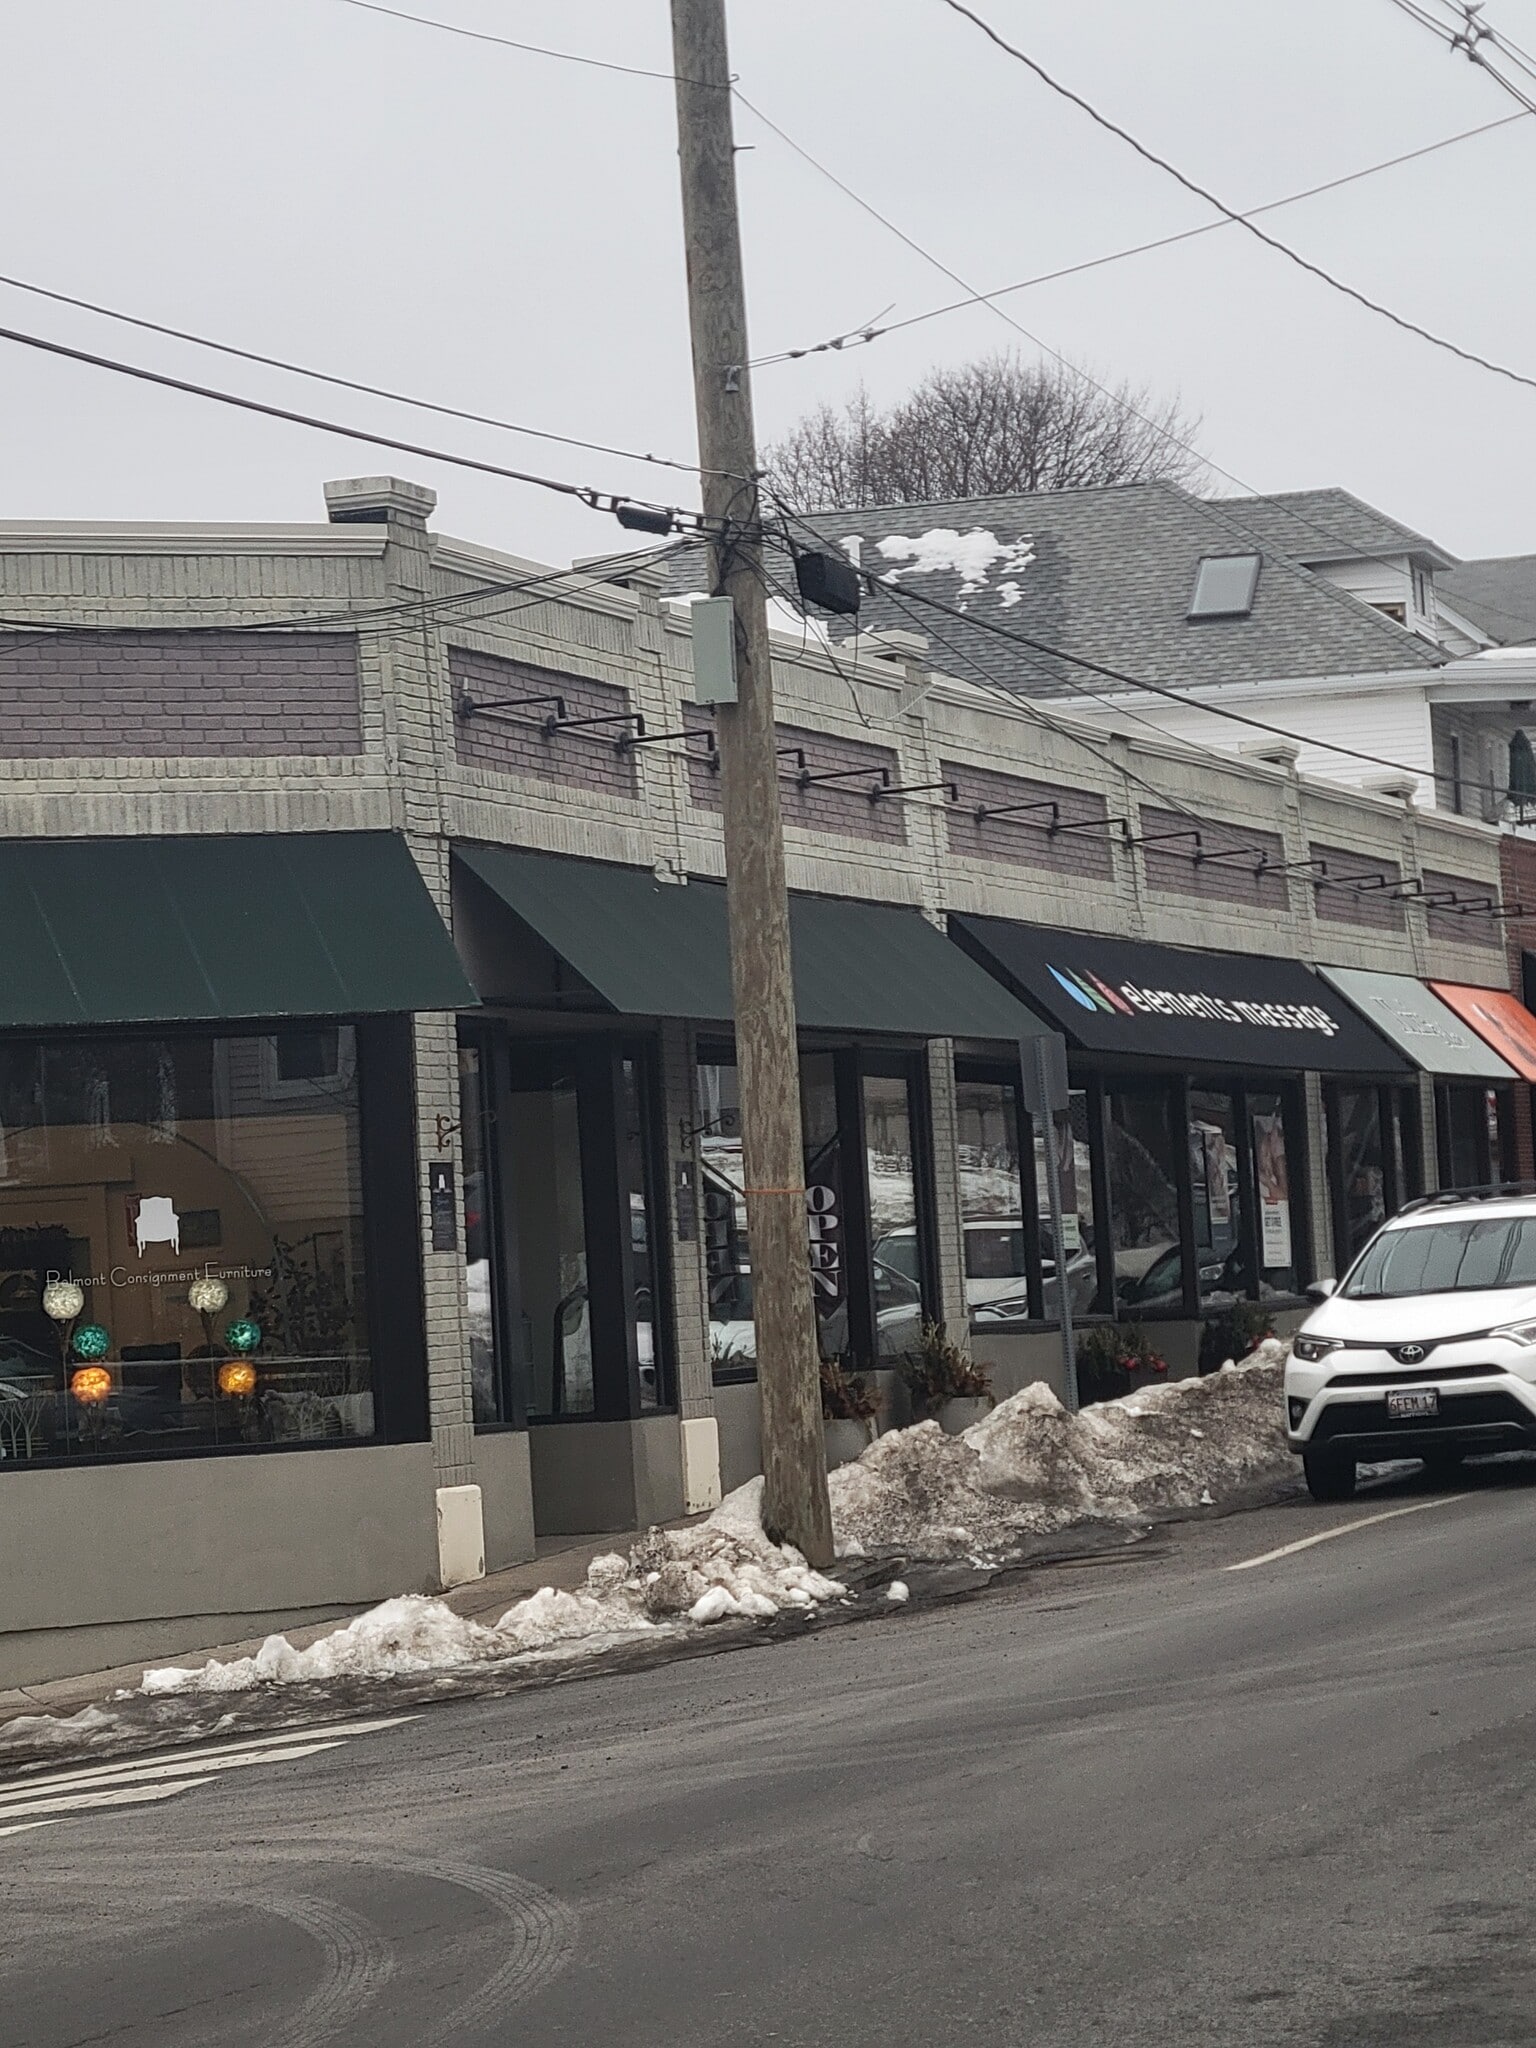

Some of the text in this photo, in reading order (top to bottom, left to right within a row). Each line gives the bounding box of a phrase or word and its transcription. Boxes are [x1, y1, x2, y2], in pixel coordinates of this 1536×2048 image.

[1119, 980, 1243, 1023] elements
[1230, 1000, 1340, 1037] massage
[804, 1185, 841, 1297] OPEN
[110, 1265, 201, 1288] Consignment
[204, 1261, 273, 1282] Furniture
[1422, 1395, 1437, 1409] 17
